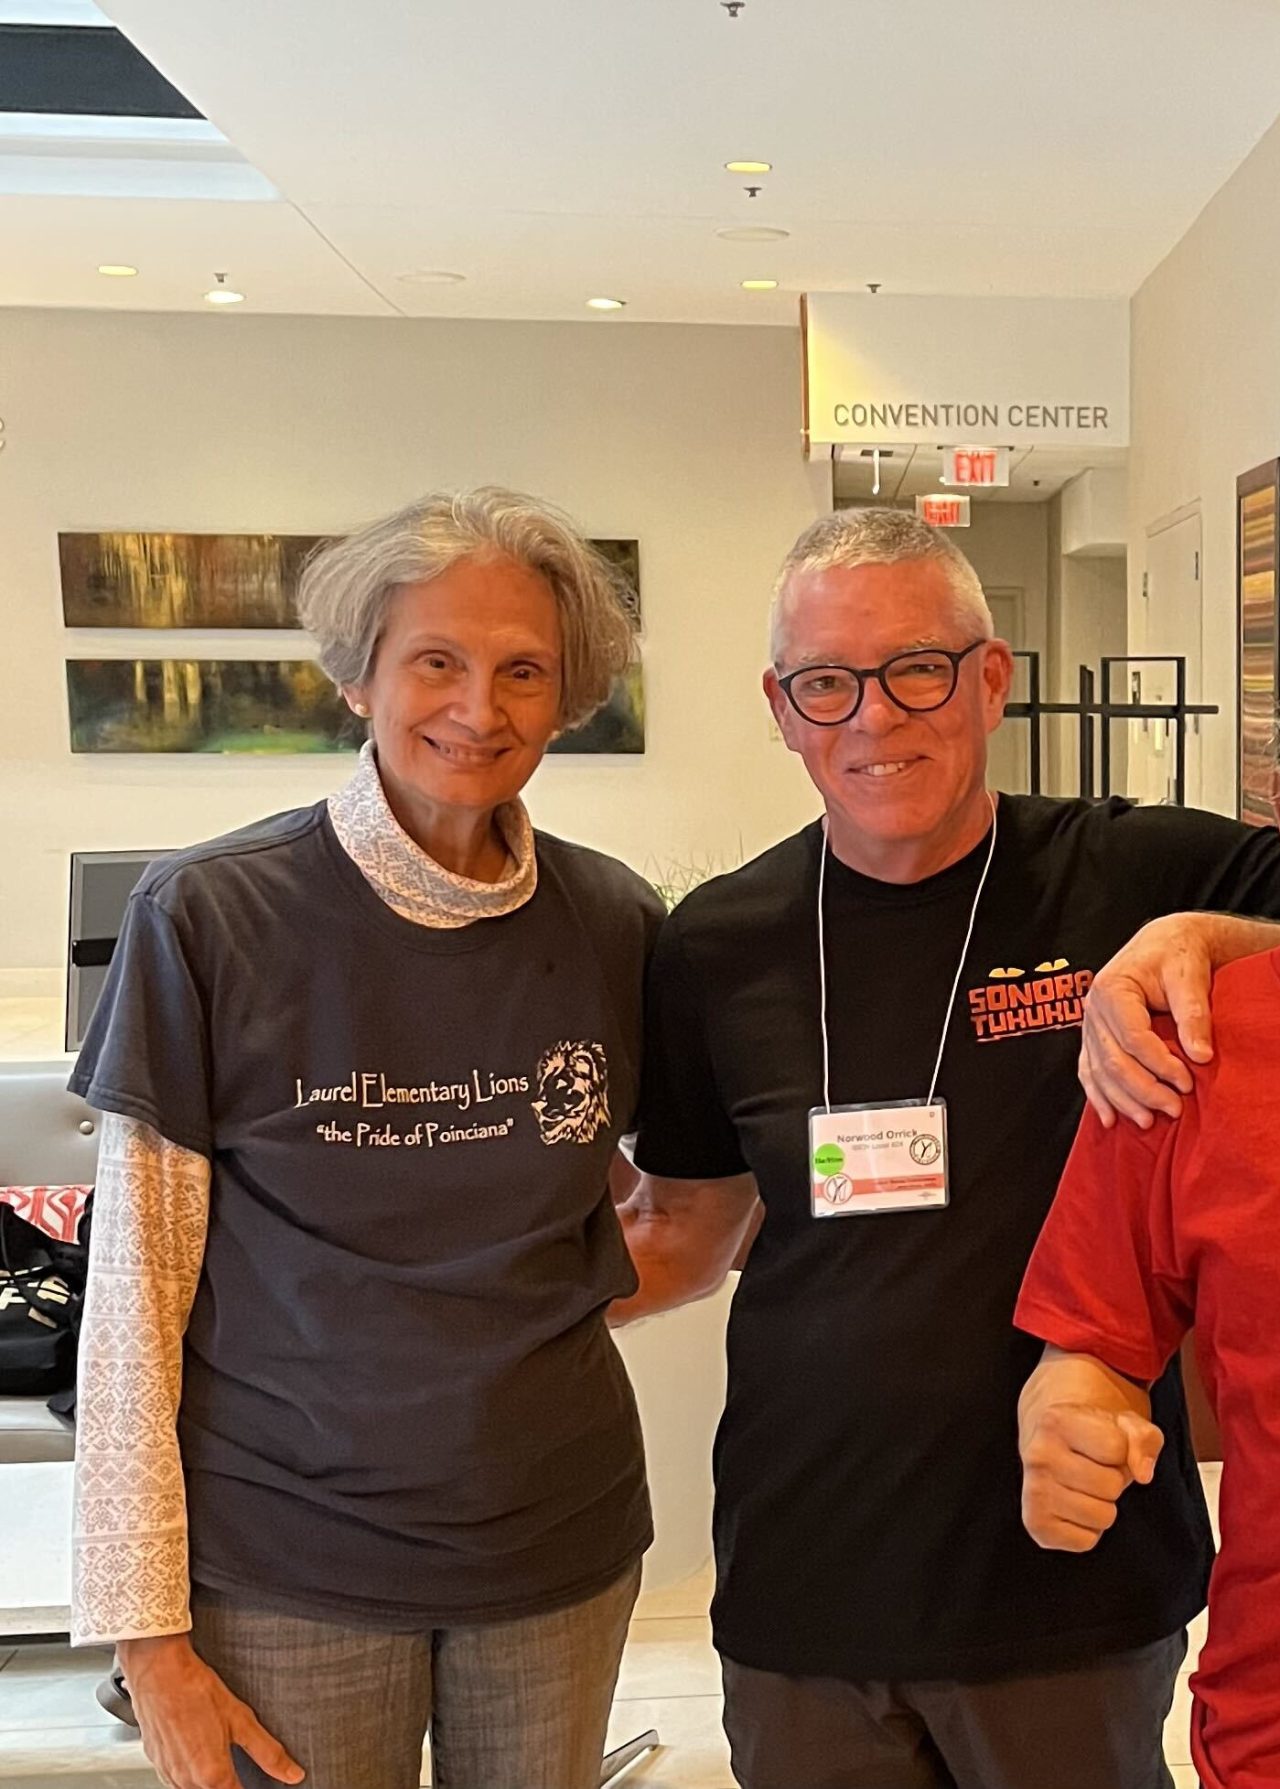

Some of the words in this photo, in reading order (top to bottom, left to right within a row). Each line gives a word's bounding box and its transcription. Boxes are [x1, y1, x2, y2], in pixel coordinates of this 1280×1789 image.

[833, 403, 998, 428] CONVENTION
[1008, 405, 1108, 429] CENTER
[955, 451, 995, 482] EXIT
[968, 969, 1095, 1014] SONORA
[970, 996, 1087, 1036] TUKUKU
[293, 1070, 357, 1108] Laurel
[361, 1072, 470, 1111] Elementary
[472, 1069, 529, 1103] Lions
[356, 1122, 401, 1147] Pride
[404, 1123, 424, 1146] of
[425, 1118, 514, 1147] Poinciana"
[837, 1131, 884, 1143] Norwood
